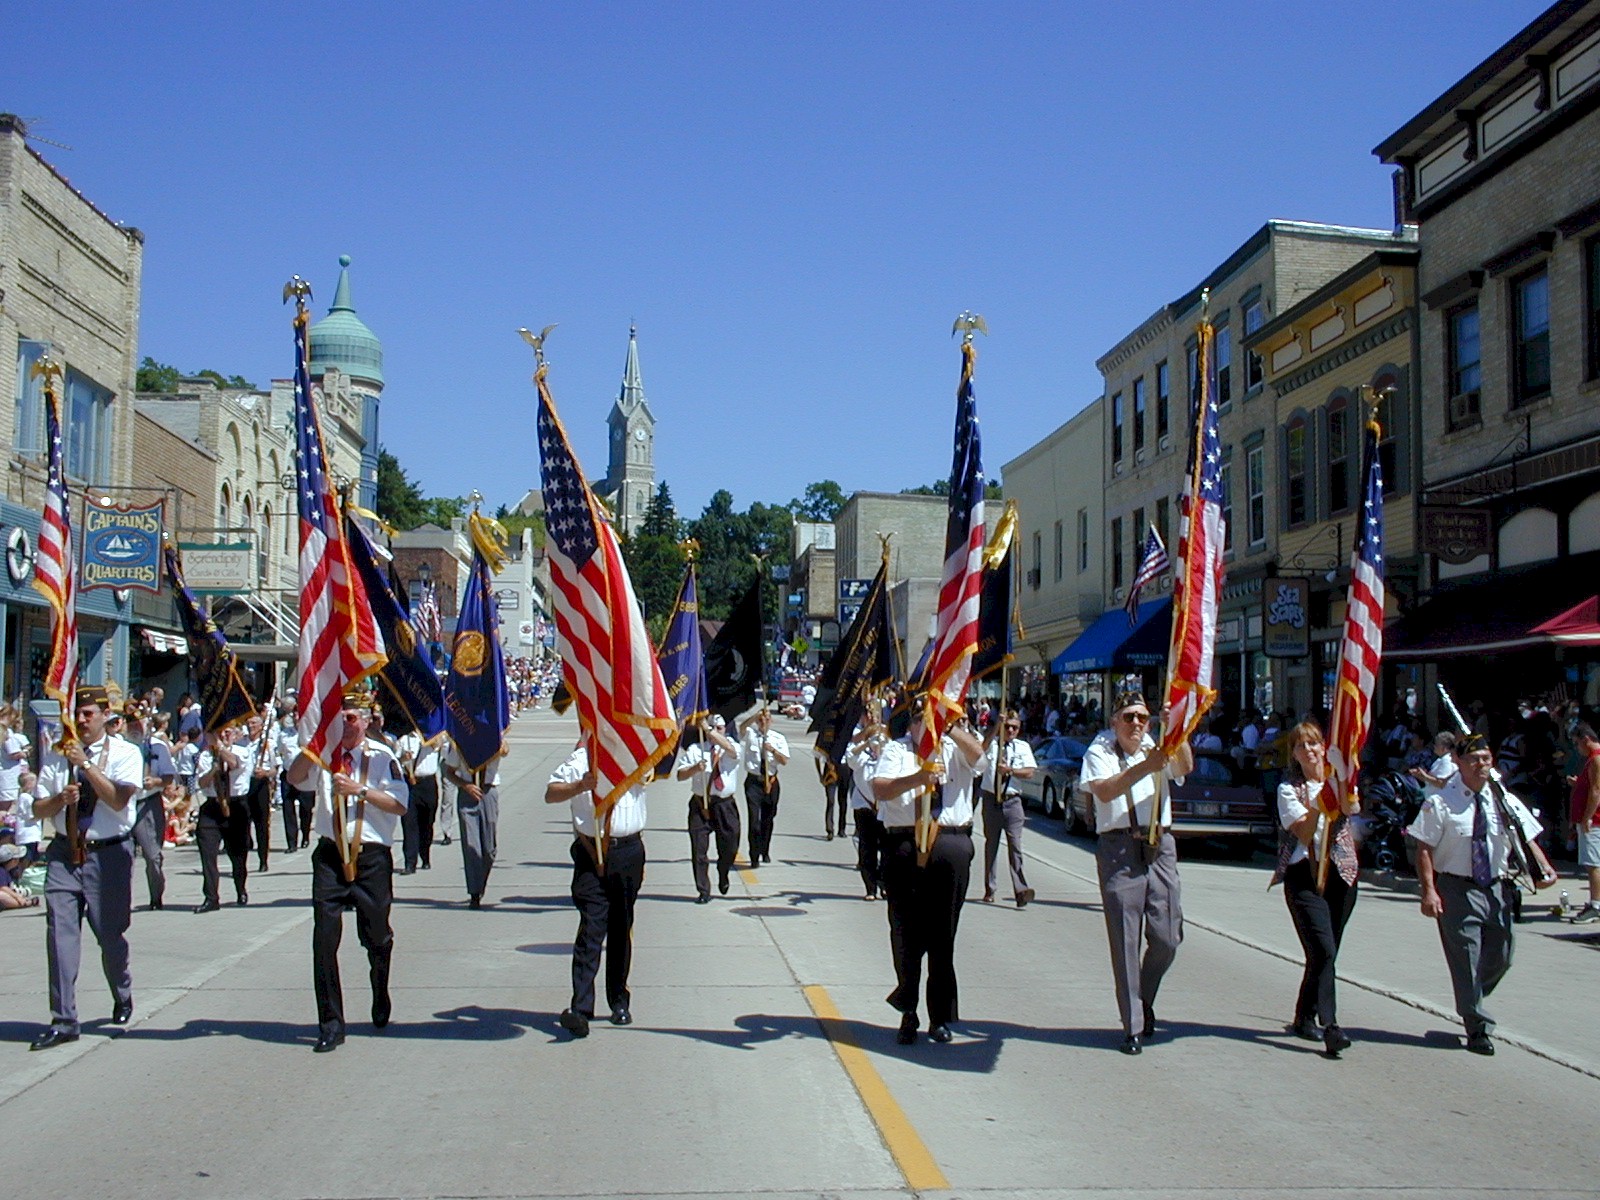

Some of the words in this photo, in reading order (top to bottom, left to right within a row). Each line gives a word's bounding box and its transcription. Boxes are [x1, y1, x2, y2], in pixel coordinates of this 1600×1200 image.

[87, 511, 158, 533] CAPTAIN'S
[187, 551, 242, 567] Serendipity
[85, 562, 155, 583] QUARTERS
